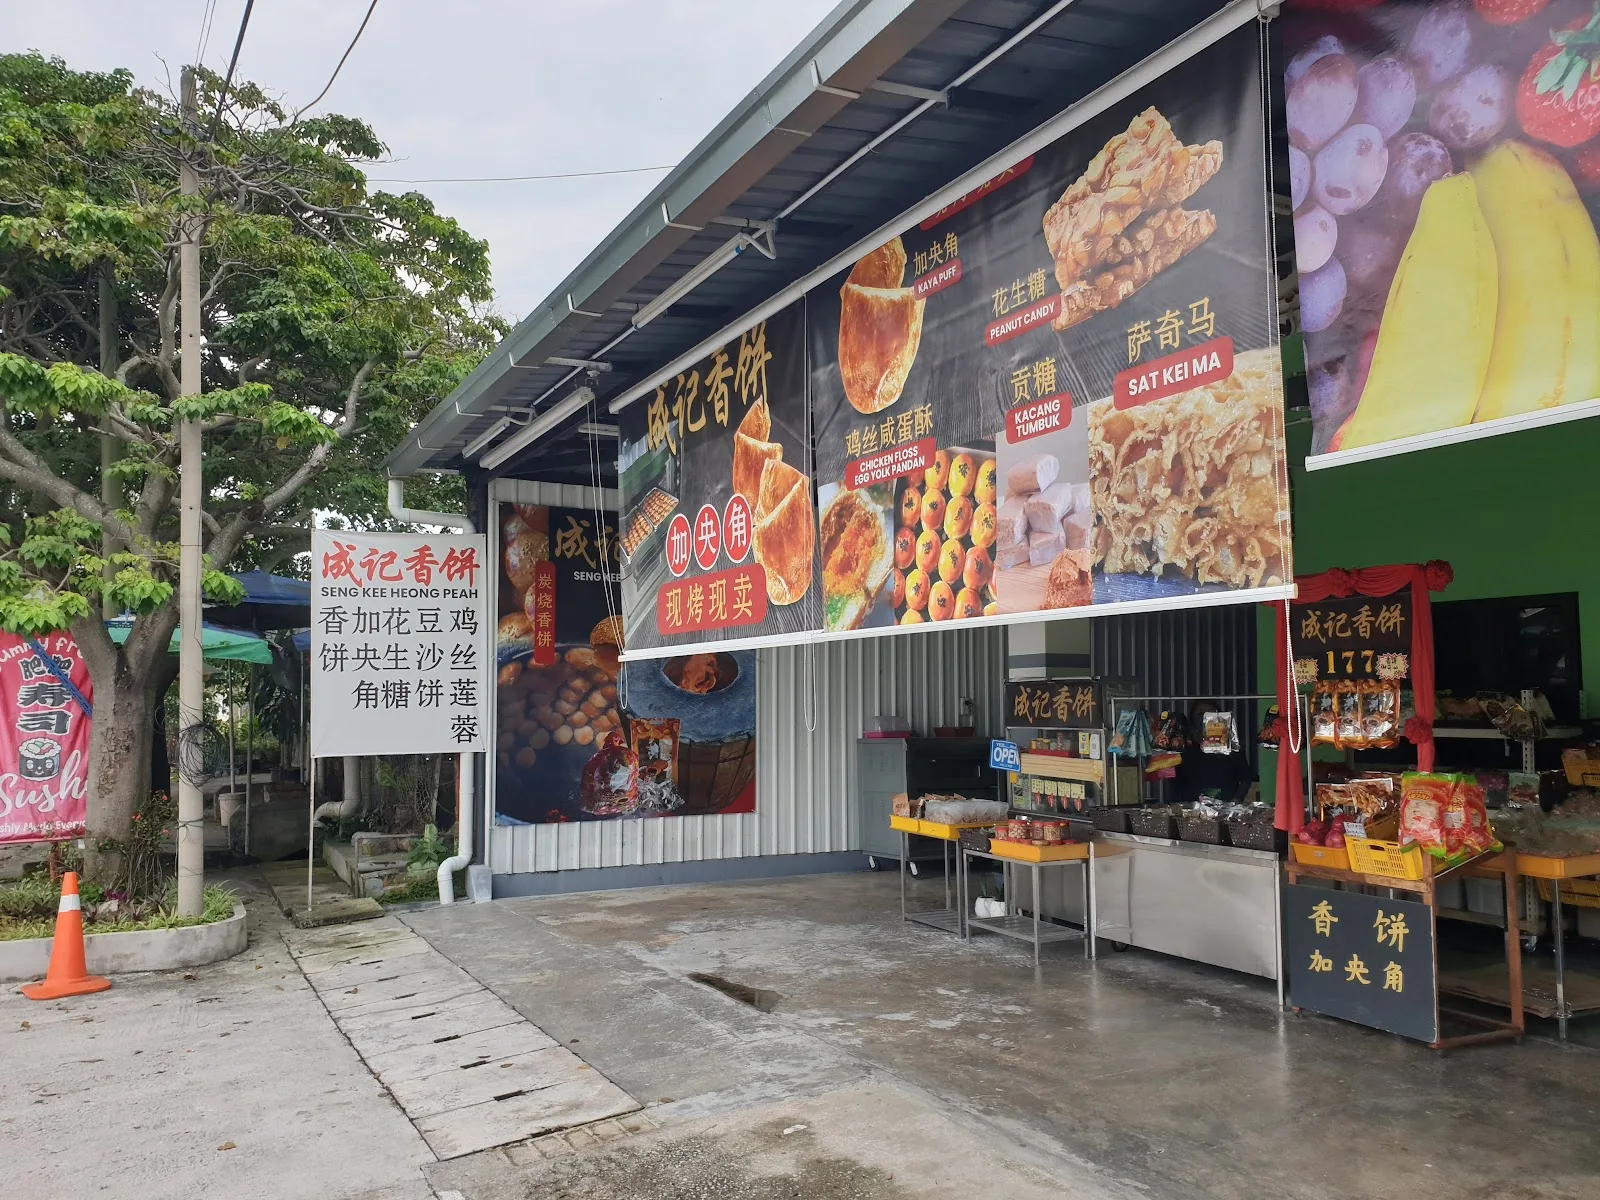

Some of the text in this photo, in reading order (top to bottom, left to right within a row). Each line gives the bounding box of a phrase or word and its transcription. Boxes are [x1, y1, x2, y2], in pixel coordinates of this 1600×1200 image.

[913, 232, 958, 277] 加央角
[918, 266, 956, 294] KAYA PUFF
[992, 268, 1046, 318] 花生糖
[990, 302, 1055, 339] PEANUT CANDY
[1127, 297, 1215, 364] 萨奇马
[647, 321, 772, 455] 成记香饼
[1010, 357, 1056, 405] 贡糖
[1128, 351, 1221, 396] SAT KEI MA
[846, 403, 933, 458] 鸡丝咸蛋酥
[1015, 400, 1060, 425] KACANG
[1016, 414, 1059, 437] TUMBUK
[855, 456, 925, 485] EGG YOLK PANDAN
[860, 446, 918, 472] CHICKEN FLOSS
[671, 503, 746, 567] 加央角
[322, 541, 480, 588] 成记香饼
[574, 571, 601, 581] SENG
[321, 587, 478, 599] SENG KEE HEONG PEAH
[537, 574, 552, 648] 炭烧香饼
[666, 573, 753, 628] 现烤现卖
[1301, 603, 1406, 642] 成记香饼
[1326, 649, 1375, 674] 177
[1014, 685, 1096, 723] 成记香饼
[993, 747, 1019, 765] OPEN
[0, 750, 87, 817] Sush
[1308, 949, 1404, 993] 加央角
